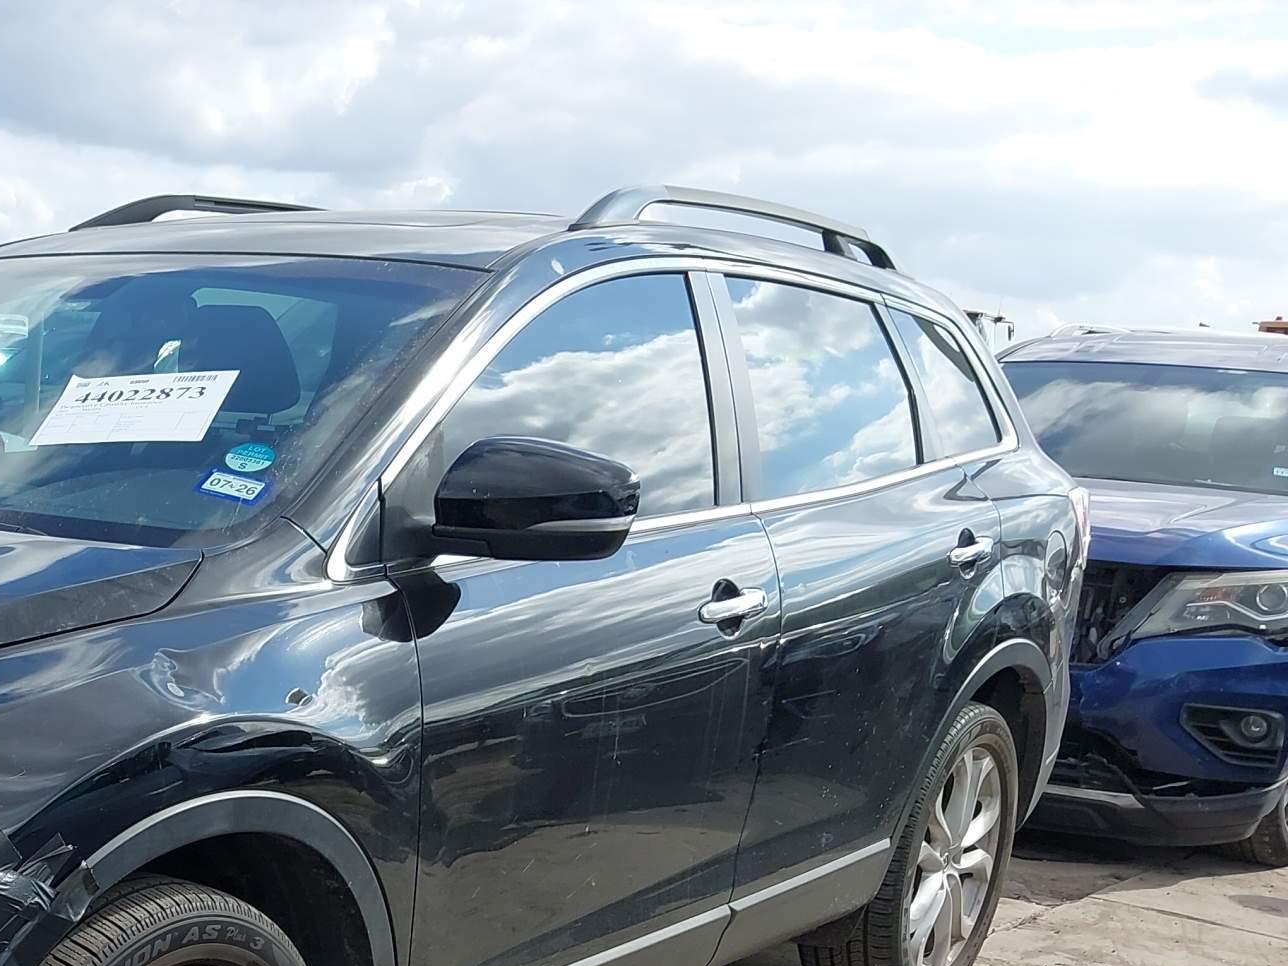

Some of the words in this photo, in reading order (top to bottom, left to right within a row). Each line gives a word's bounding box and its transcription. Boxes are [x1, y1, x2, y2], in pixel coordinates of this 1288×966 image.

[74, 386, 208, 404] 44022873
[181, 924, 222, 945] AS
[226, 926, 247, 943] Plus
[249, 936, 265, 950] 3
